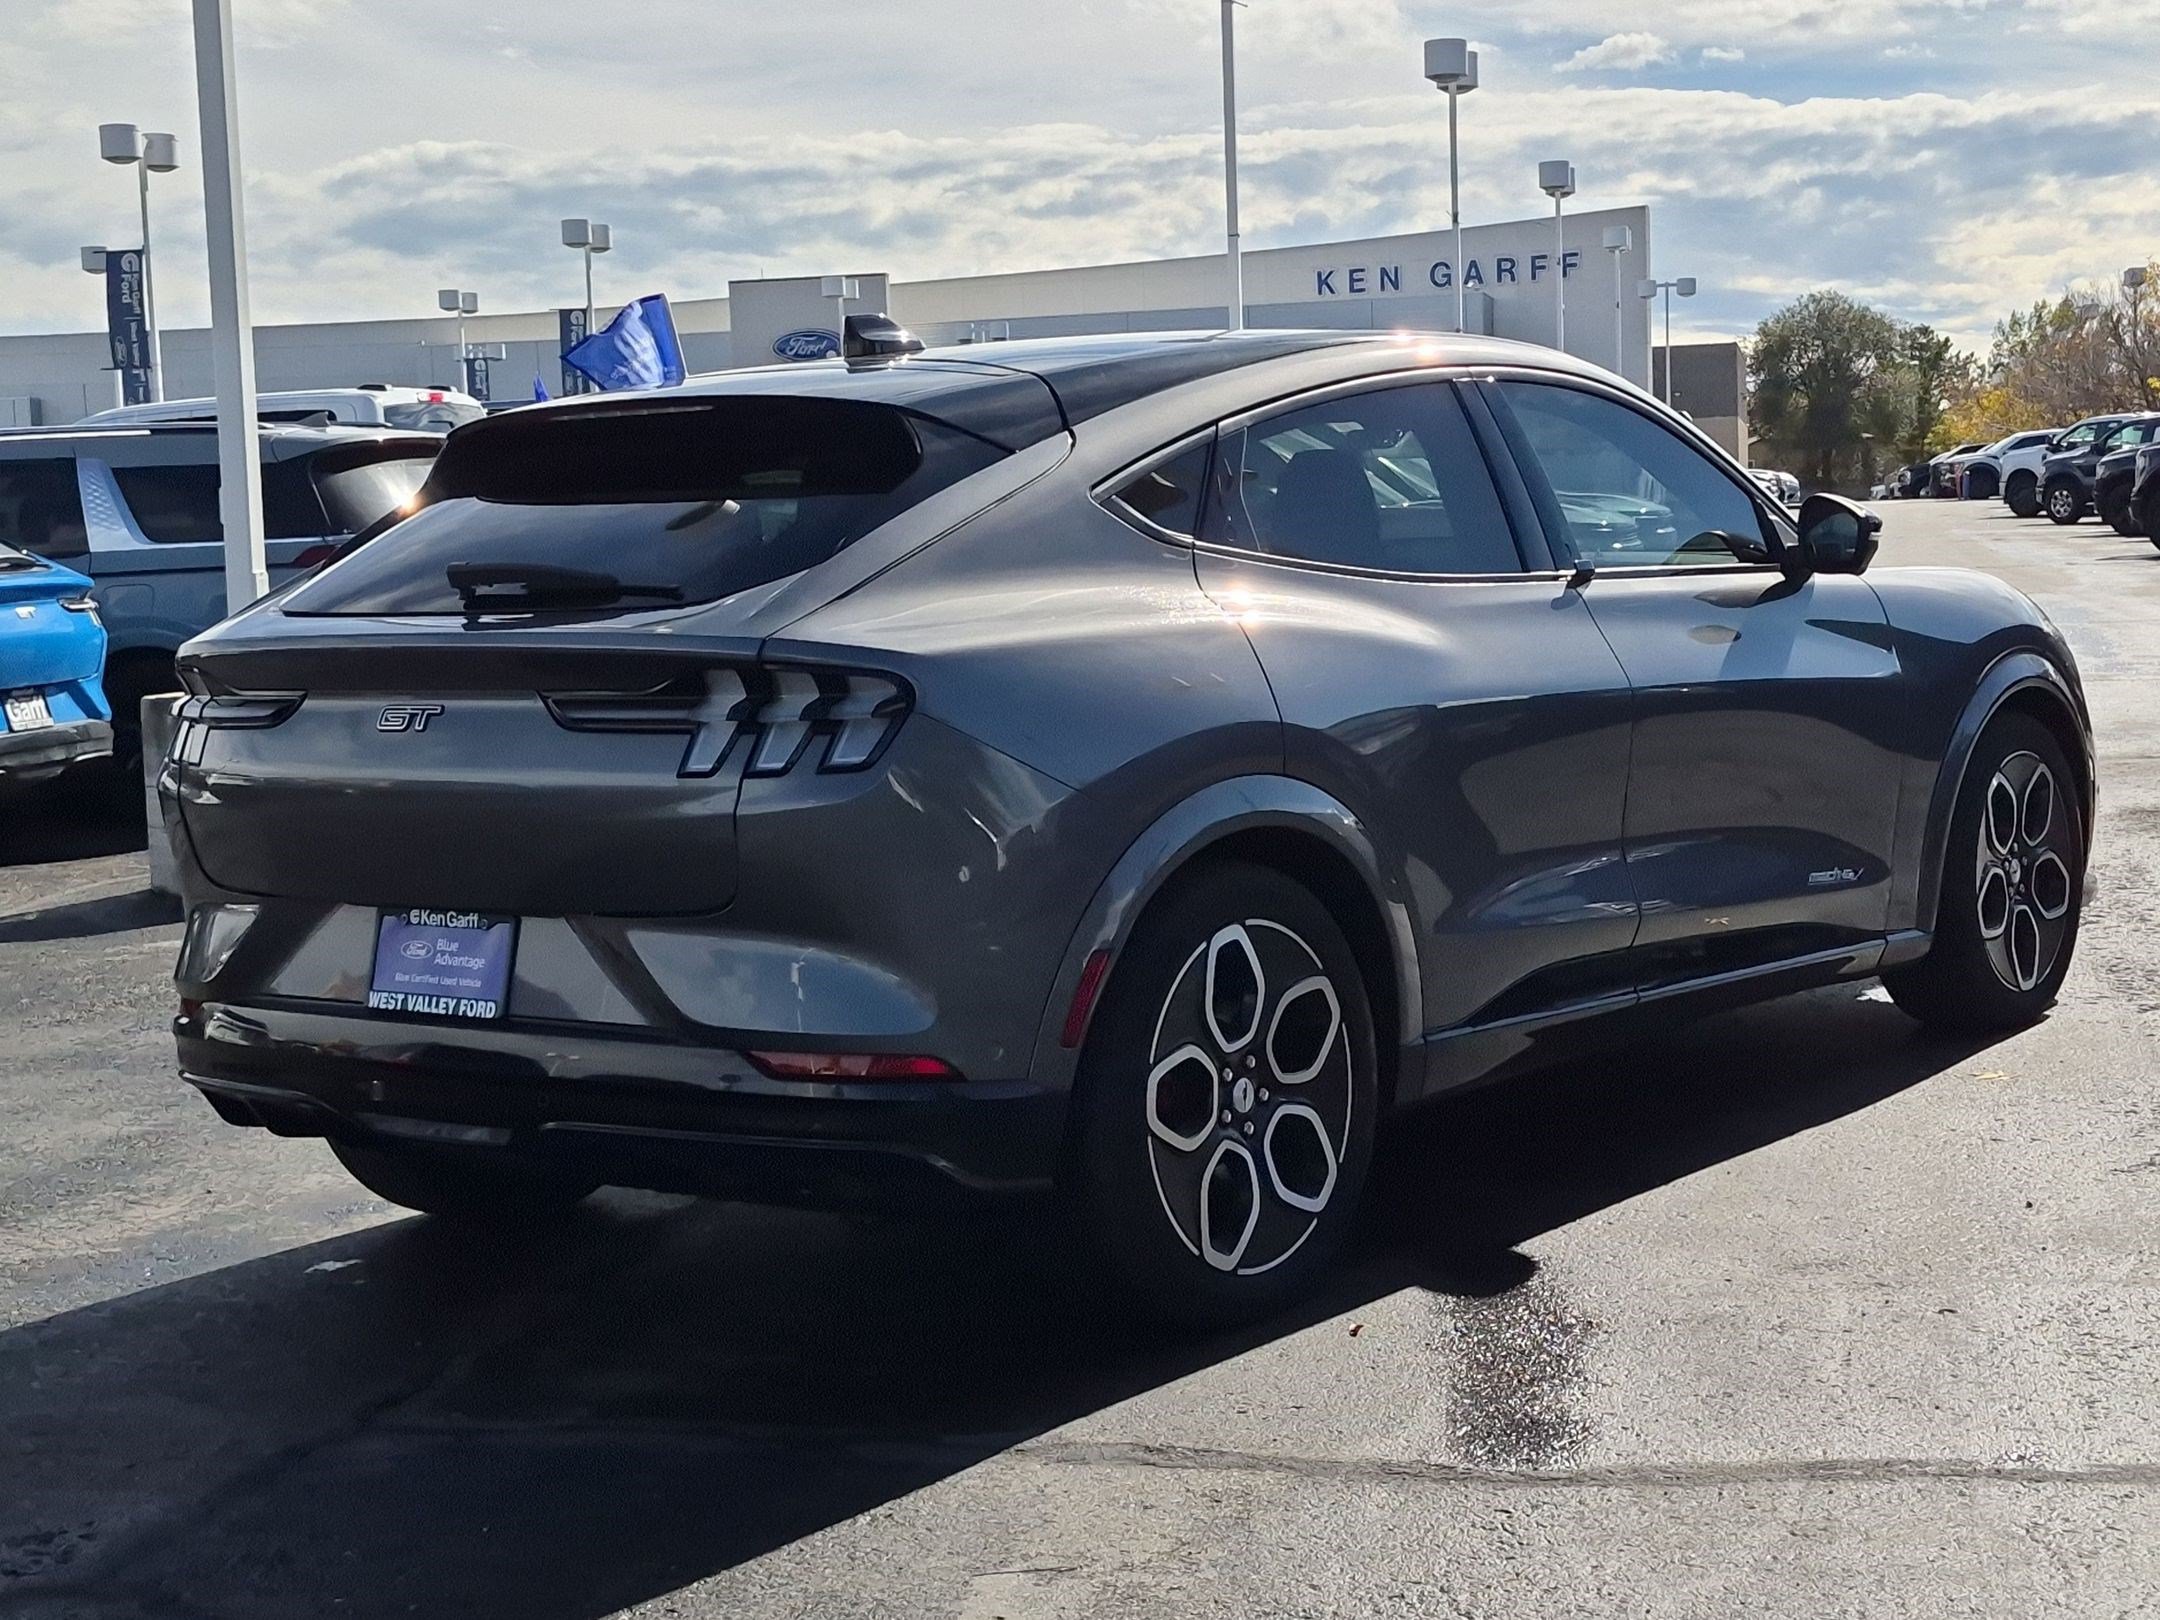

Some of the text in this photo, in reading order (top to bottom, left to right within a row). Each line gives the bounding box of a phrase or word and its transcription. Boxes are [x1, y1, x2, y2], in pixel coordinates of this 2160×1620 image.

[1316, 252, 1580, 296] KEN GARFF
[121, 274, 132, 303] Ford
[785, 336, 828, 356] Ford
[376, 705, 443, 732] GT
[421, 909, 446, 927] Ken
[446, 911, 479, 929] Garff
[436, 938, 460, 952] Blue
[433, 953, 486, 970] Advantage
[368, 991, 496, 1019] WEST VALLEY FORD
